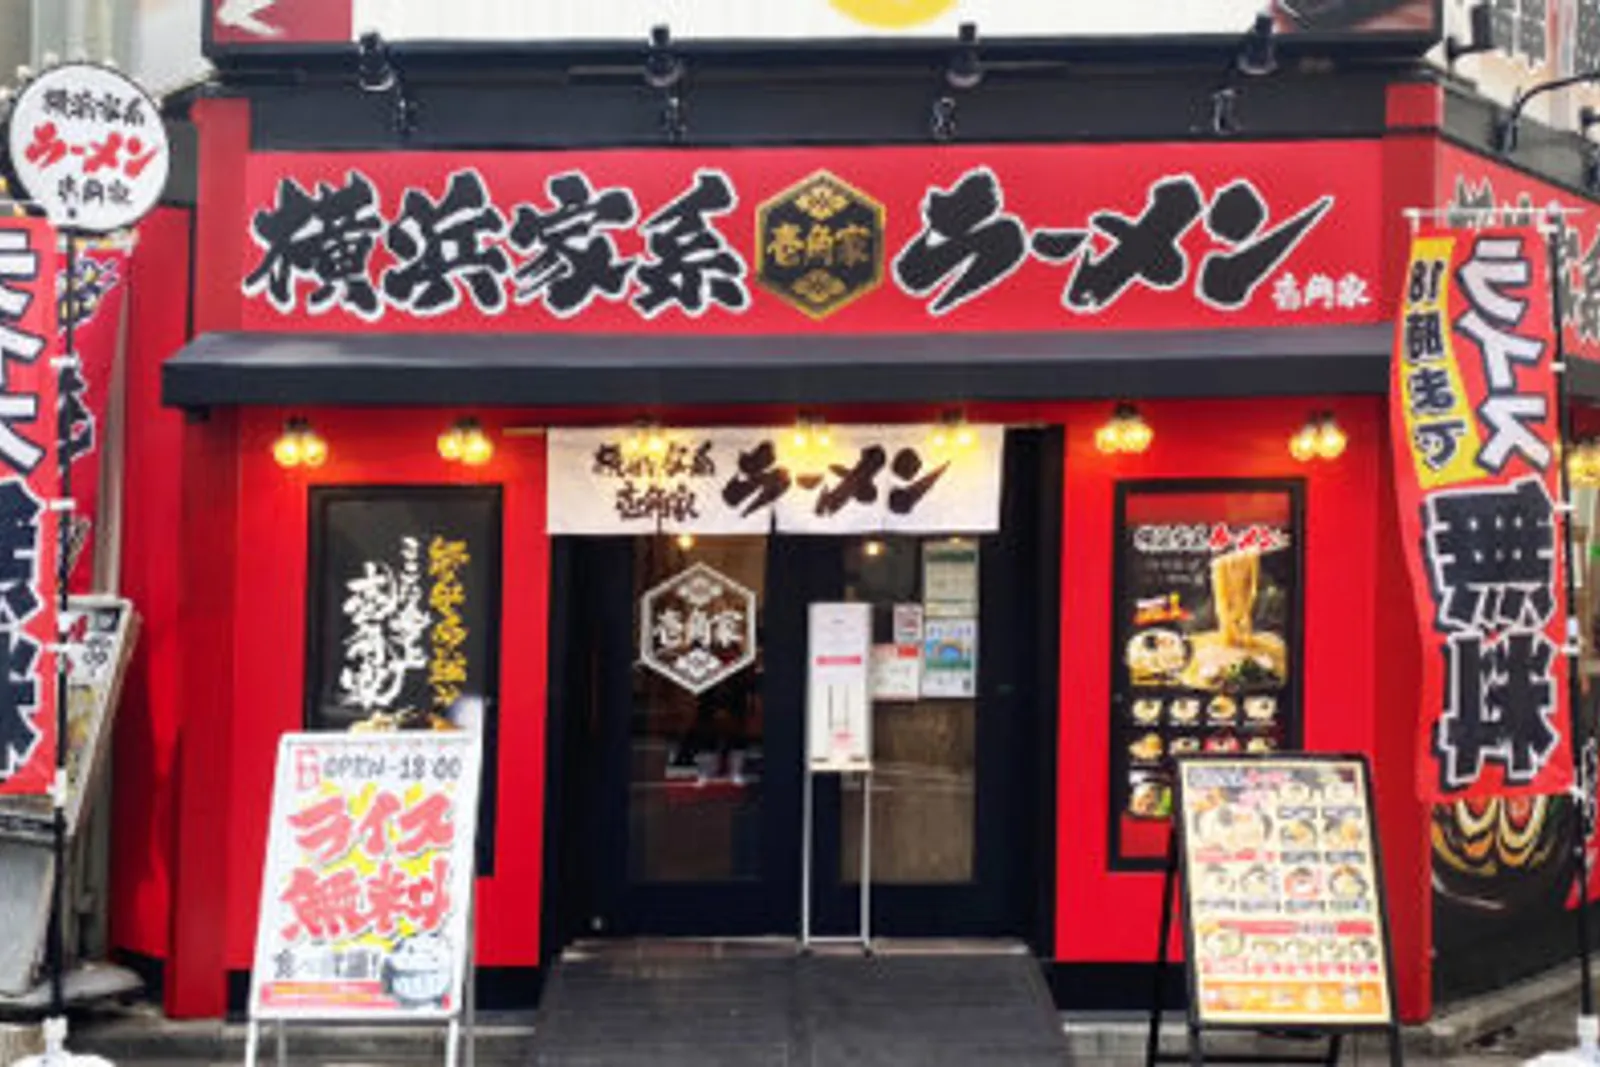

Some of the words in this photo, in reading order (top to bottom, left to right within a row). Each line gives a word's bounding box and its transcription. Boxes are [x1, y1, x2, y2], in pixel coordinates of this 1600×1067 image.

[25, 121, 158, 179] ラーメン
[242, 169, 752, 320] 横浜家系
[893, 165, 1335, 316] ラーメン
[722, 440, 951, 518] ラーメン
[286, 792, 454, 864] ライス
[279, 857, 454, 942] 無料
